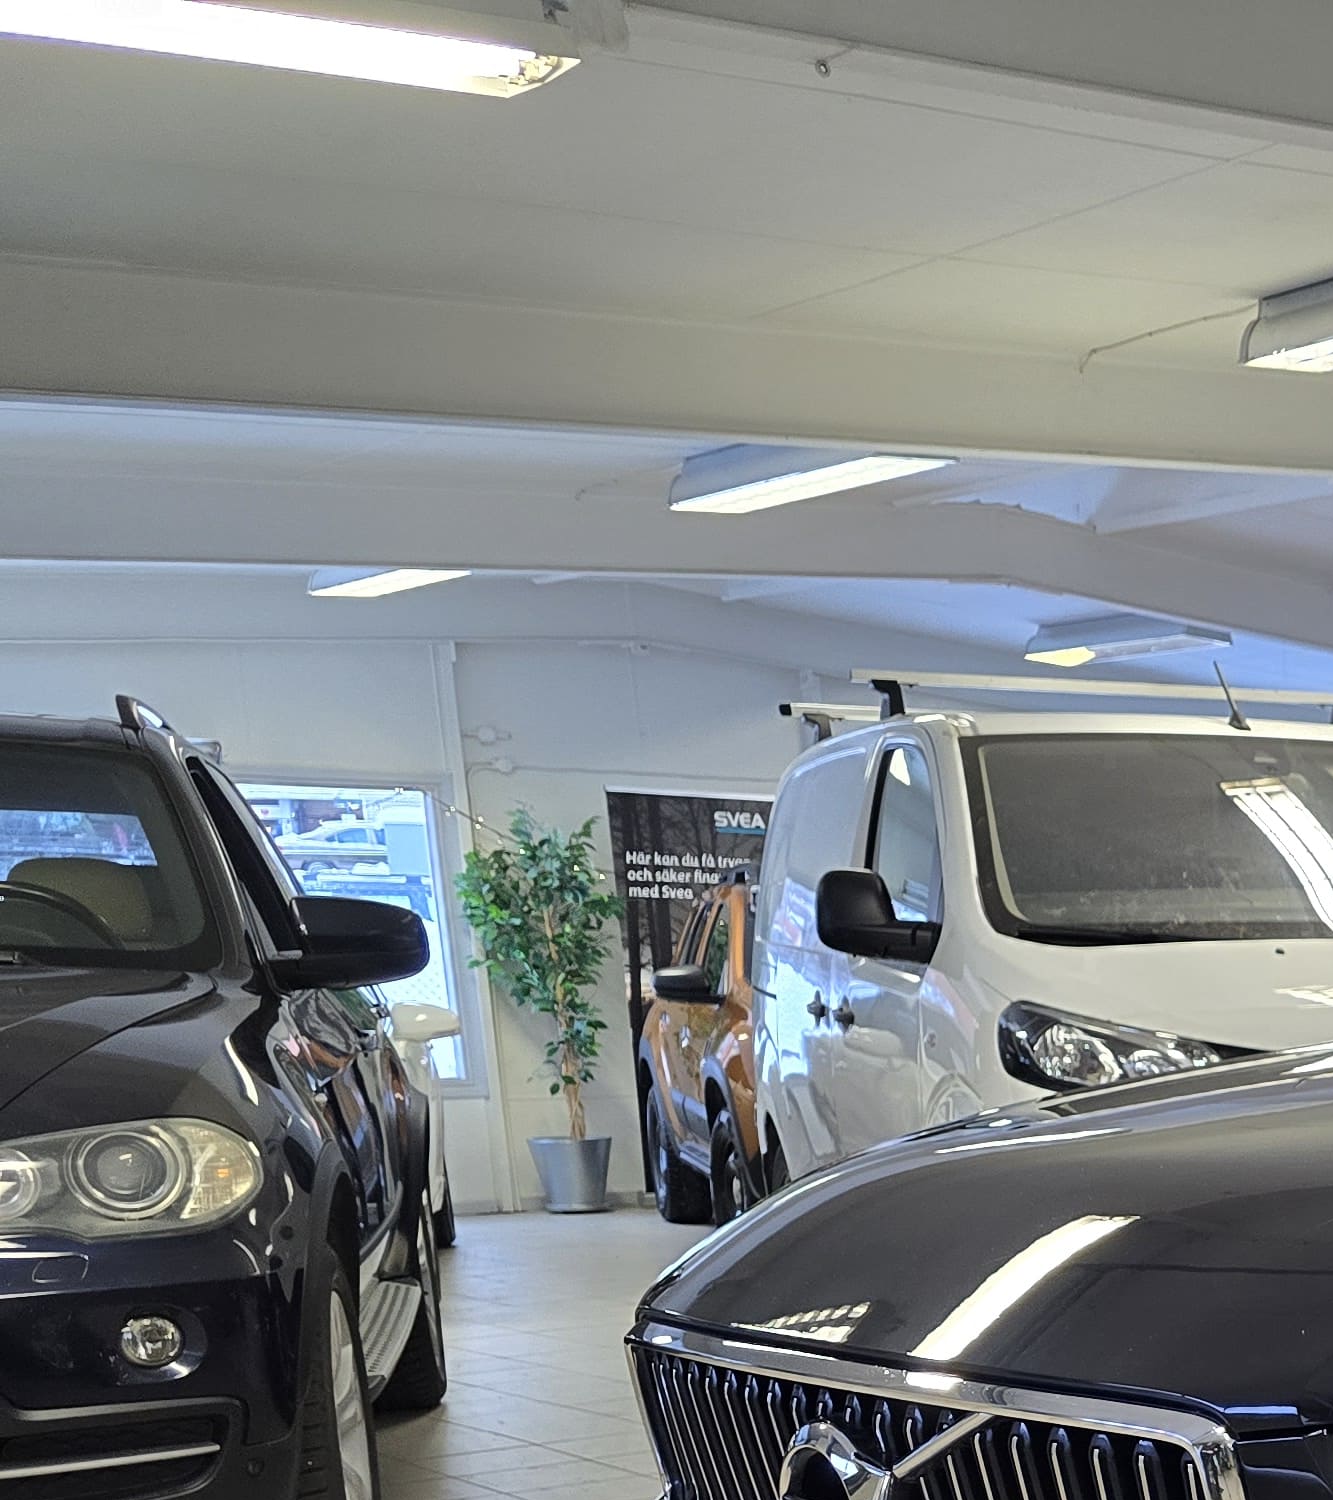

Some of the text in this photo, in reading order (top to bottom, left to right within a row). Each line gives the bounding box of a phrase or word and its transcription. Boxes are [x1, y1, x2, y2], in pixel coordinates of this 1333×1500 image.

[714, 810, 766, 829] SVEA
[625, 850, 652, 866] Här
[654, 851, 680, 867] kan
[681, 852, 700, 868] du
[701, 852, 716, 868] få
[627, 867, 653, 882] och
[655, 867, 691, 884] säker
[628, 884, 694, 900] med Svea
